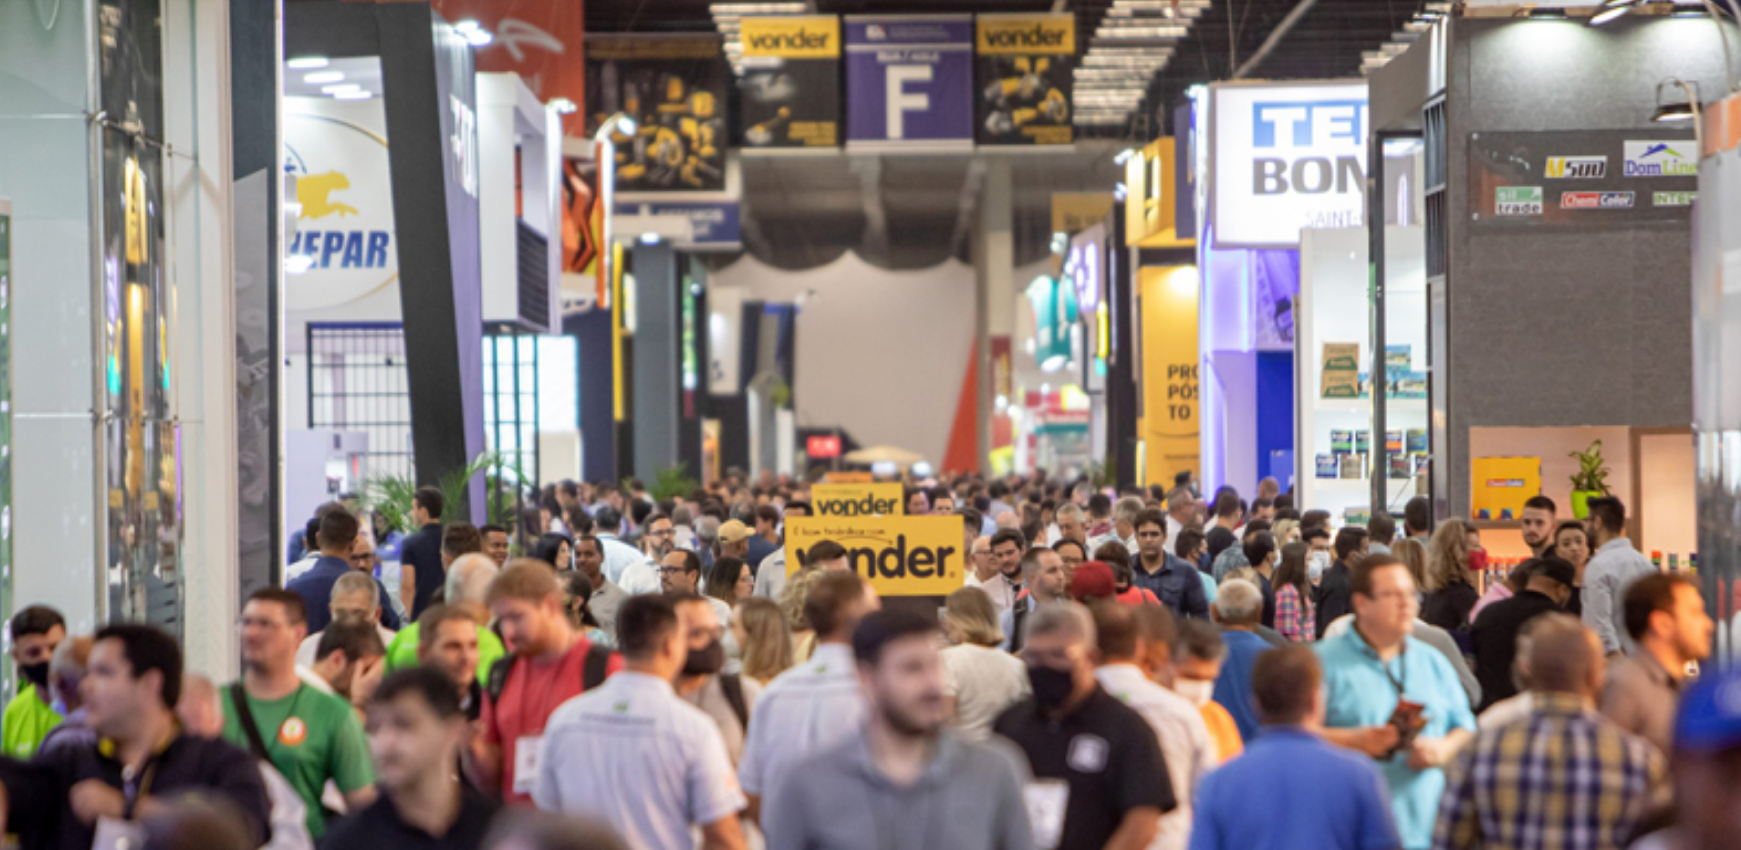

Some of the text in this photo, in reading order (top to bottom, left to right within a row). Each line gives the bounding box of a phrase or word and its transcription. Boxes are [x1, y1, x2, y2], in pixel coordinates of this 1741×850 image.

[749, 28, 830, 49] vonder
[984, 24, 1066, 46] vonder
[886, 65, 932, 139] F
[1260, 104, 1367, 146] TE
[1498, 203, 1540, 214] trade
[1168, 405, 1191, 420] TO
[817, 493, 898, 515] vonder
